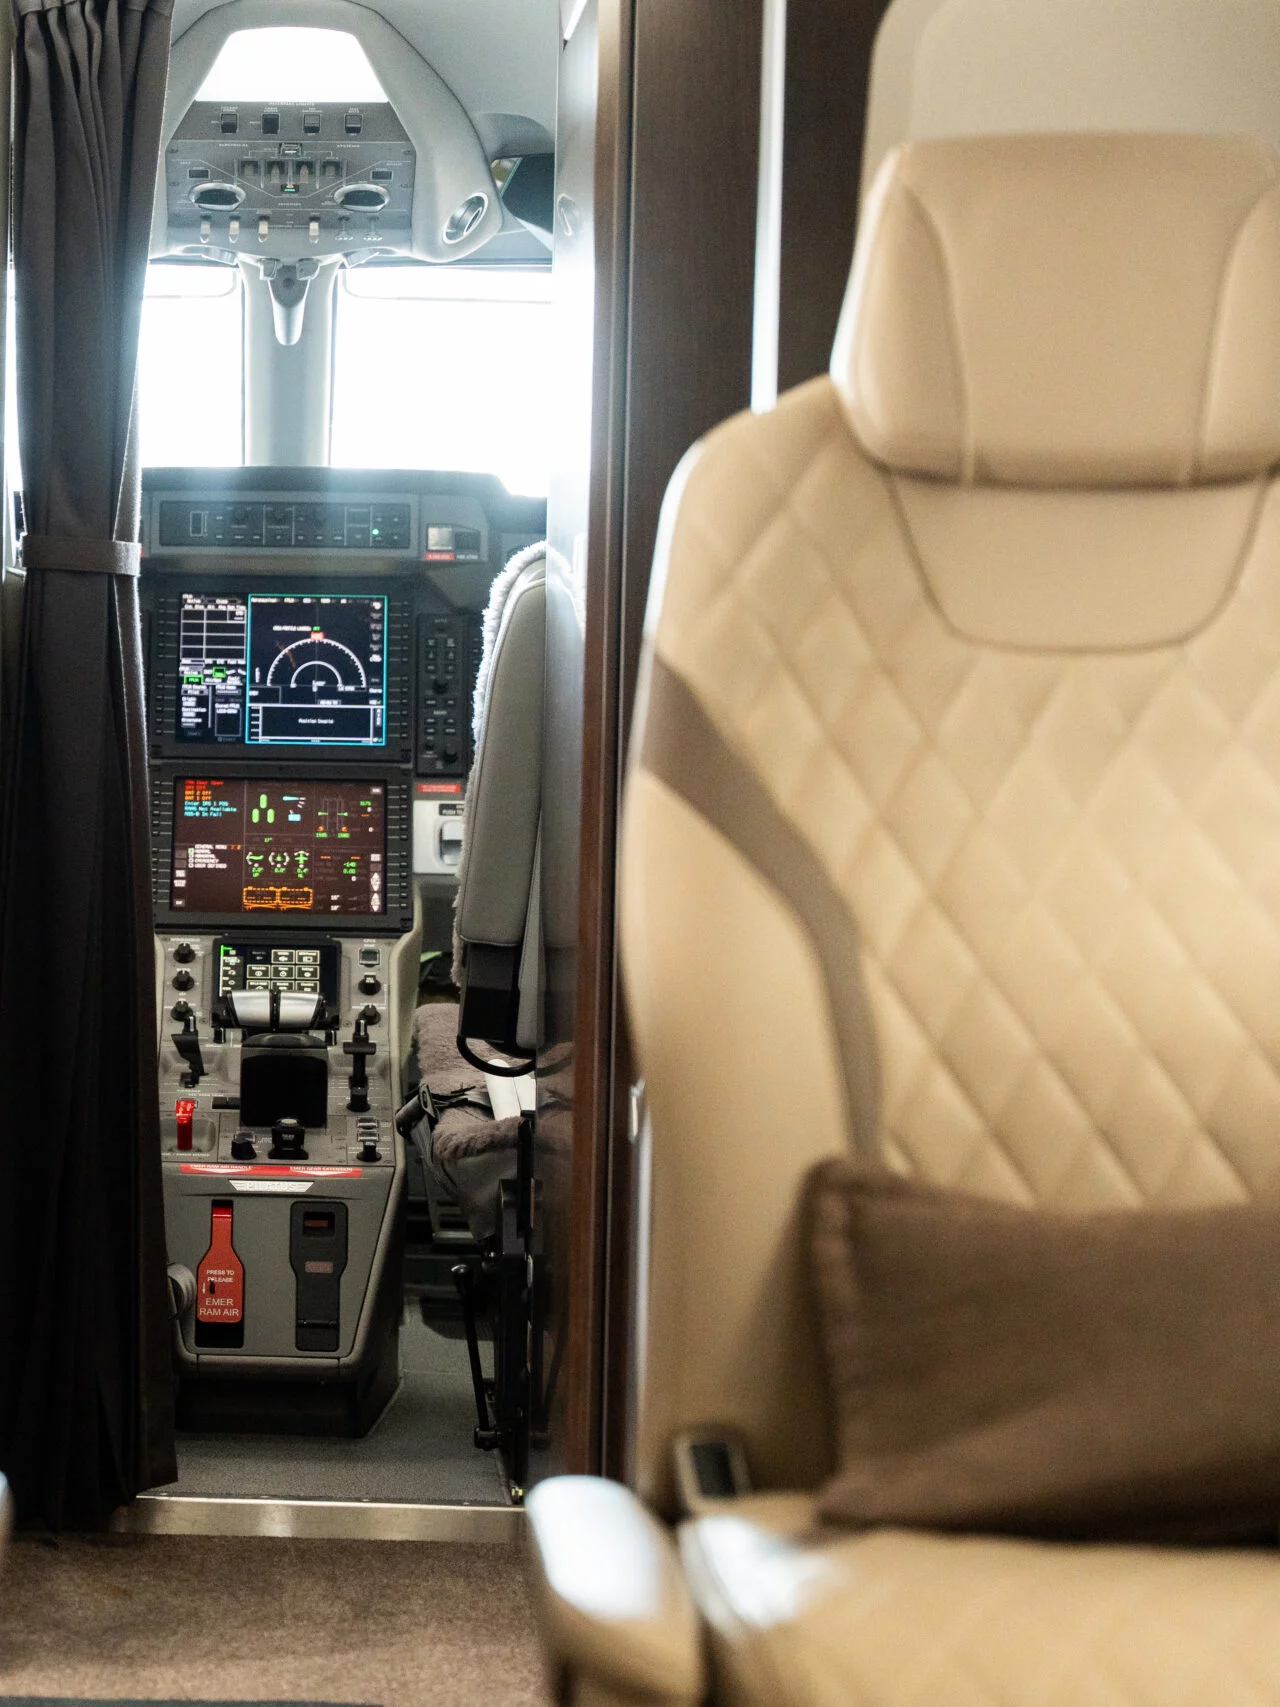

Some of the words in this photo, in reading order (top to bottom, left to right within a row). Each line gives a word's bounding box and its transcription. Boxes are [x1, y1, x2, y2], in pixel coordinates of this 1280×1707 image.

[246, 1181, 296, 1191] PILATUS
[205, 1297, 234, 1306] EMER
[199, 1307, 221, 1316] RAM
[222, 1308, 240, 1317] AIR
